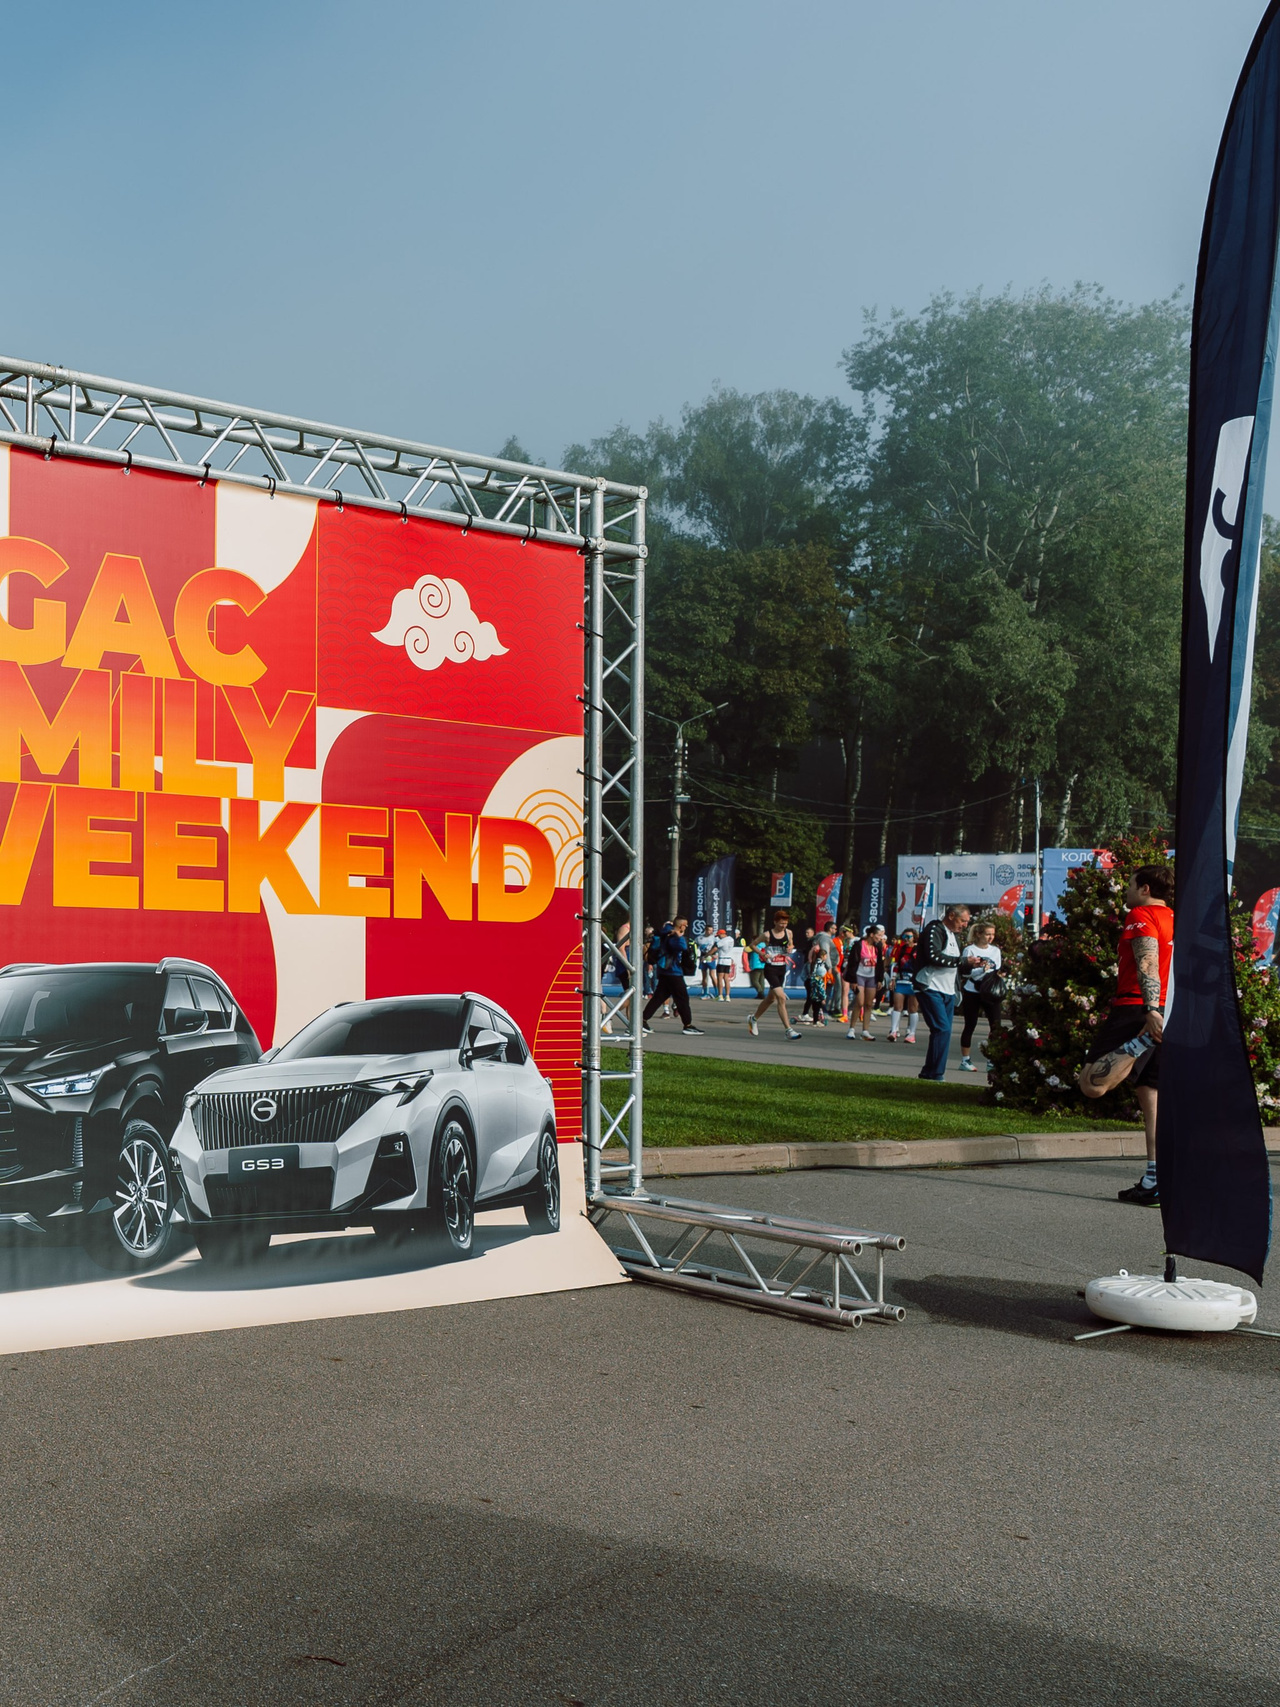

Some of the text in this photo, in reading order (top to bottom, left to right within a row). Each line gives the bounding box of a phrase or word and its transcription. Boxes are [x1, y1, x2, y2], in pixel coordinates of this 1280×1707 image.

[711, 887, 720, 933] шофис.рф
[869, 877, 880, 923] ЭВОКОМ
[241, 1158, 285, 1171] GS3
